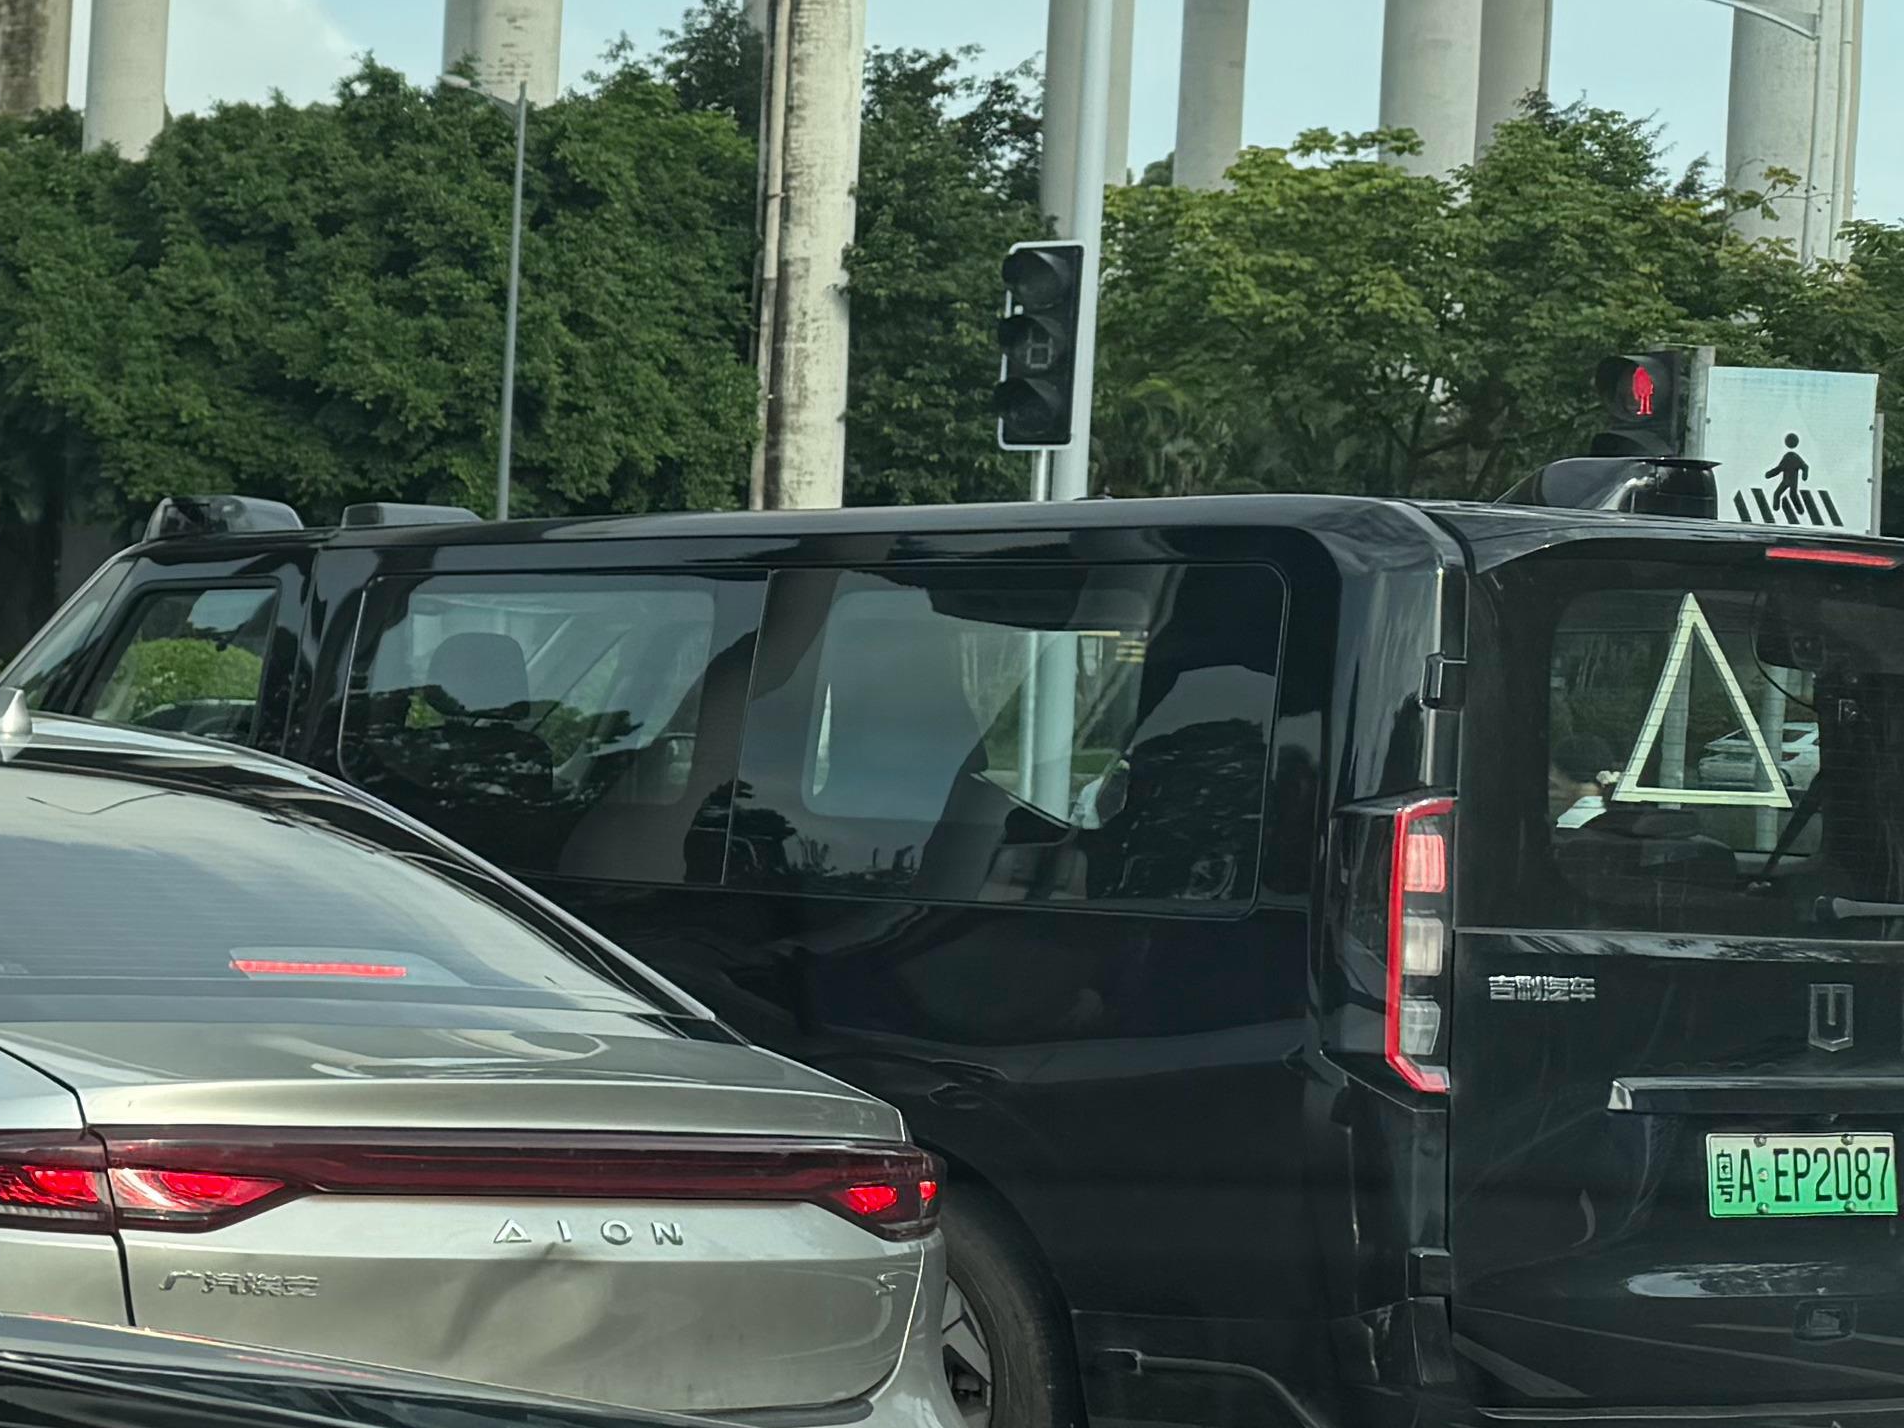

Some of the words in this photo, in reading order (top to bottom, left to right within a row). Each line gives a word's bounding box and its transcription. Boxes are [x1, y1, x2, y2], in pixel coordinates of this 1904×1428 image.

[1489, 975, 1595, 1002] 吉利汽车
[493, 1219, 684, 1245] AION
